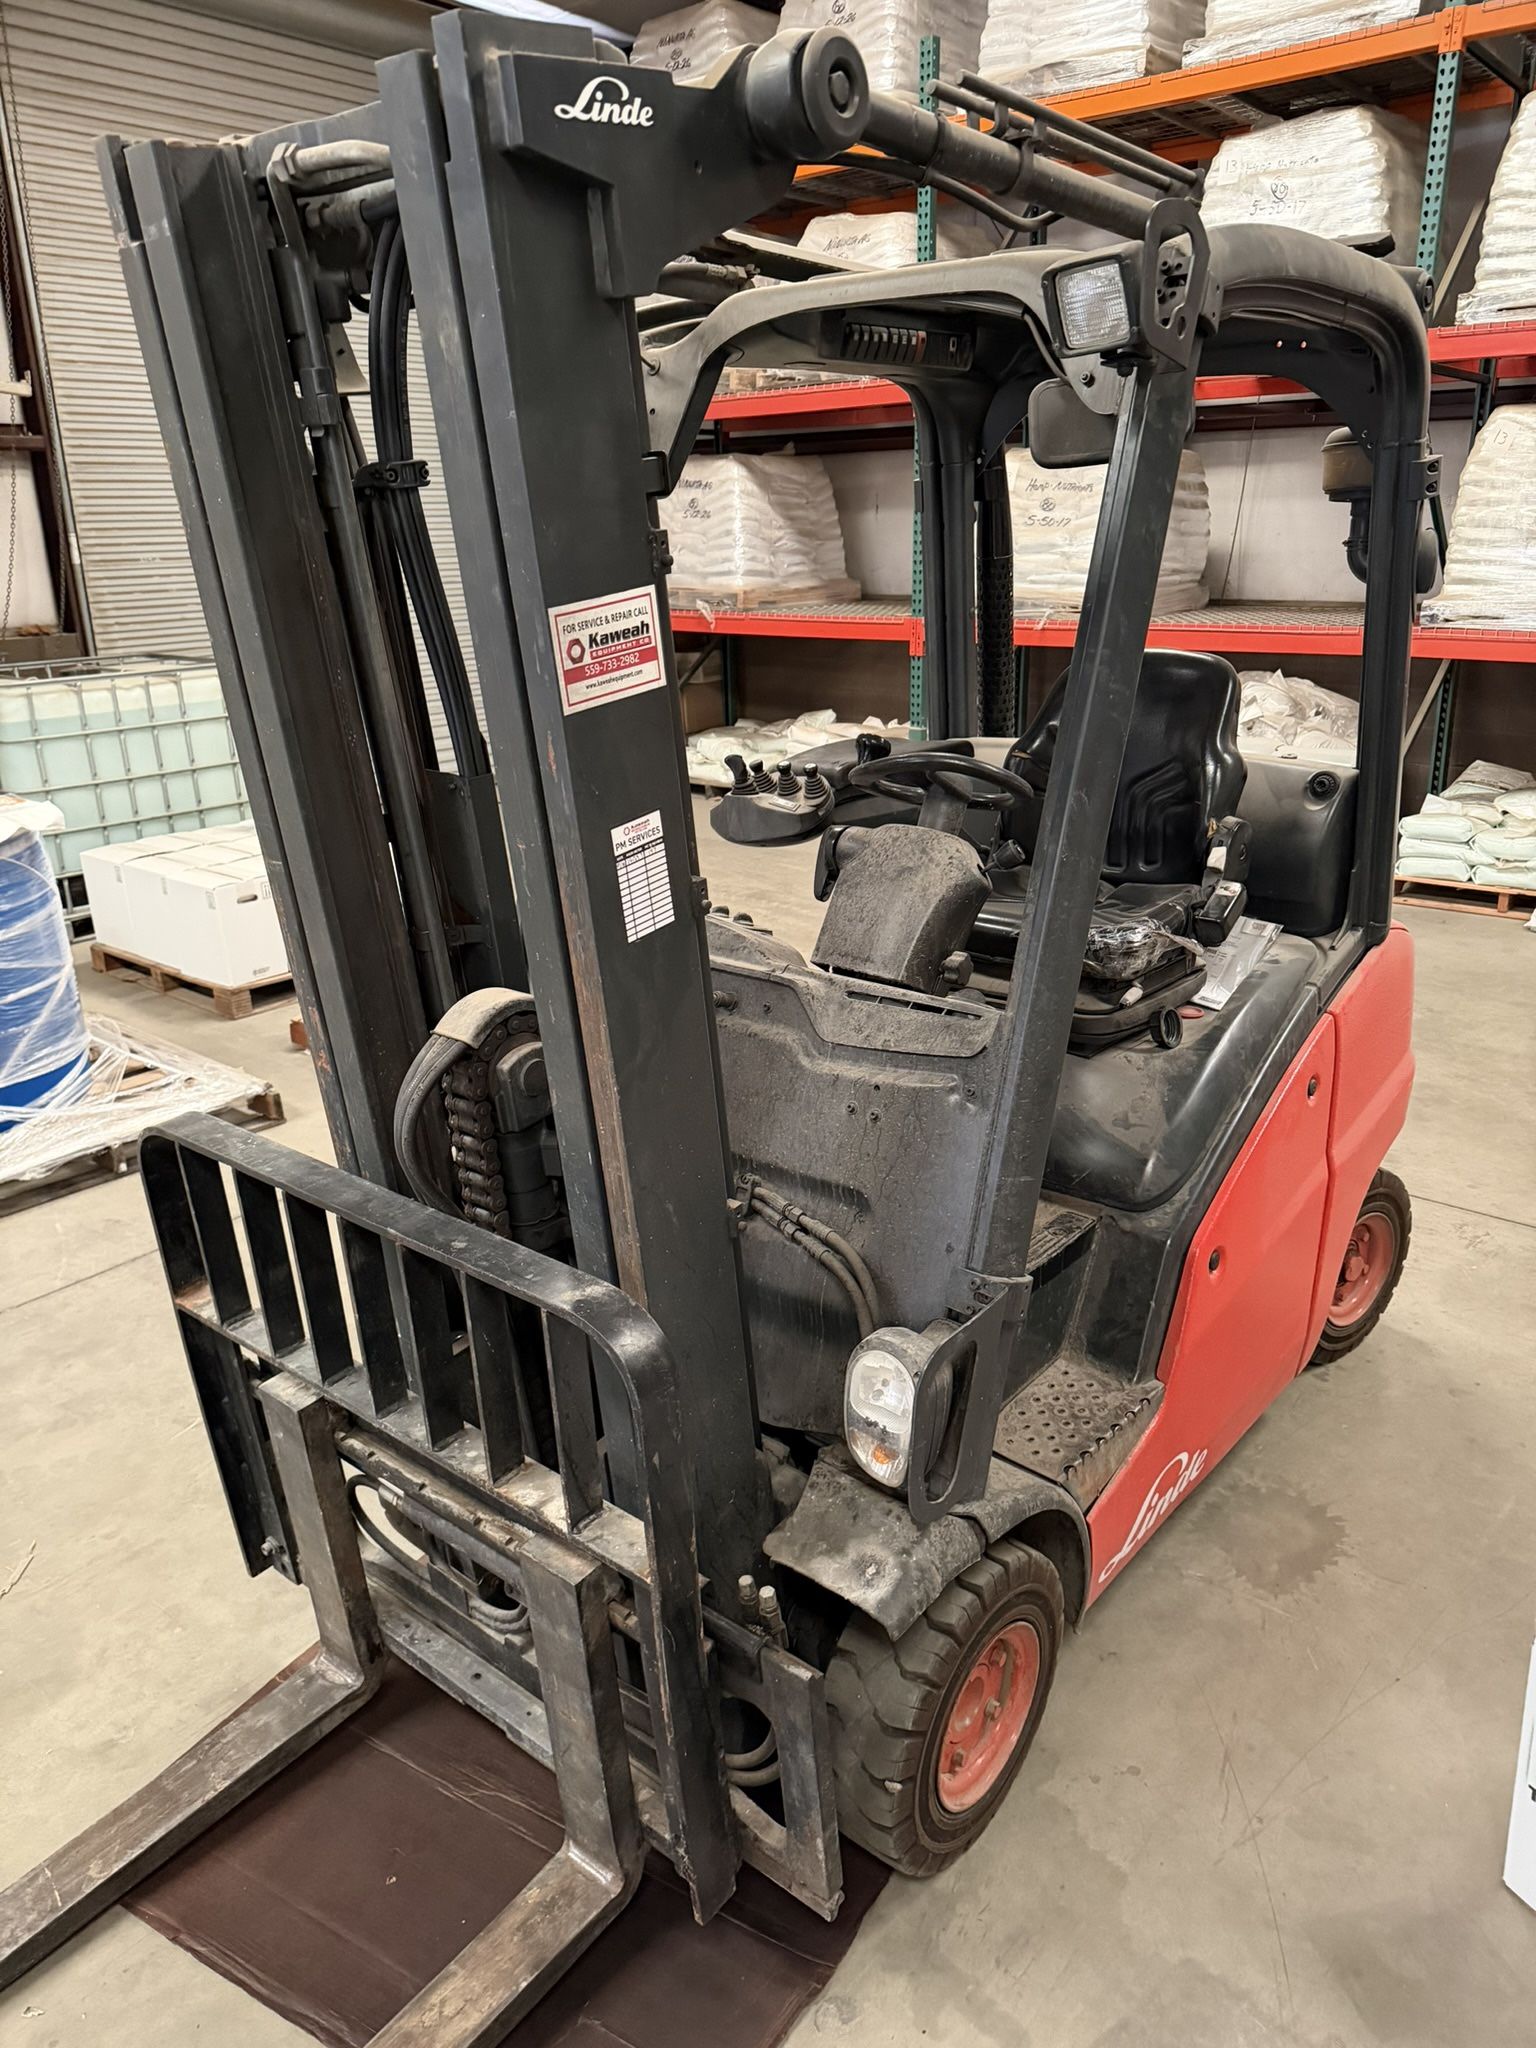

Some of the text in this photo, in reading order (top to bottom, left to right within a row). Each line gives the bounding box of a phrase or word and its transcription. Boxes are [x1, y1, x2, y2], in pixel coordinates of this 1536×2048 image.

[553, 75, 655, 128] Linde
[562, 605, 649, 635] FOR SERVICE & REPAIR CALL
[588, 620, 650, 650] Kaweah
[592, 641, 637, 657] EQUIPMENT
[585, 652, 640, 677] 559-733-2982
[585, 669, 644, 690] www.kaweahequipment.com
[615, 840, 627, 852] PM
[627, 825, 661, 847] SERVICES
[1098, 1448, 1208, 1584] Linde
